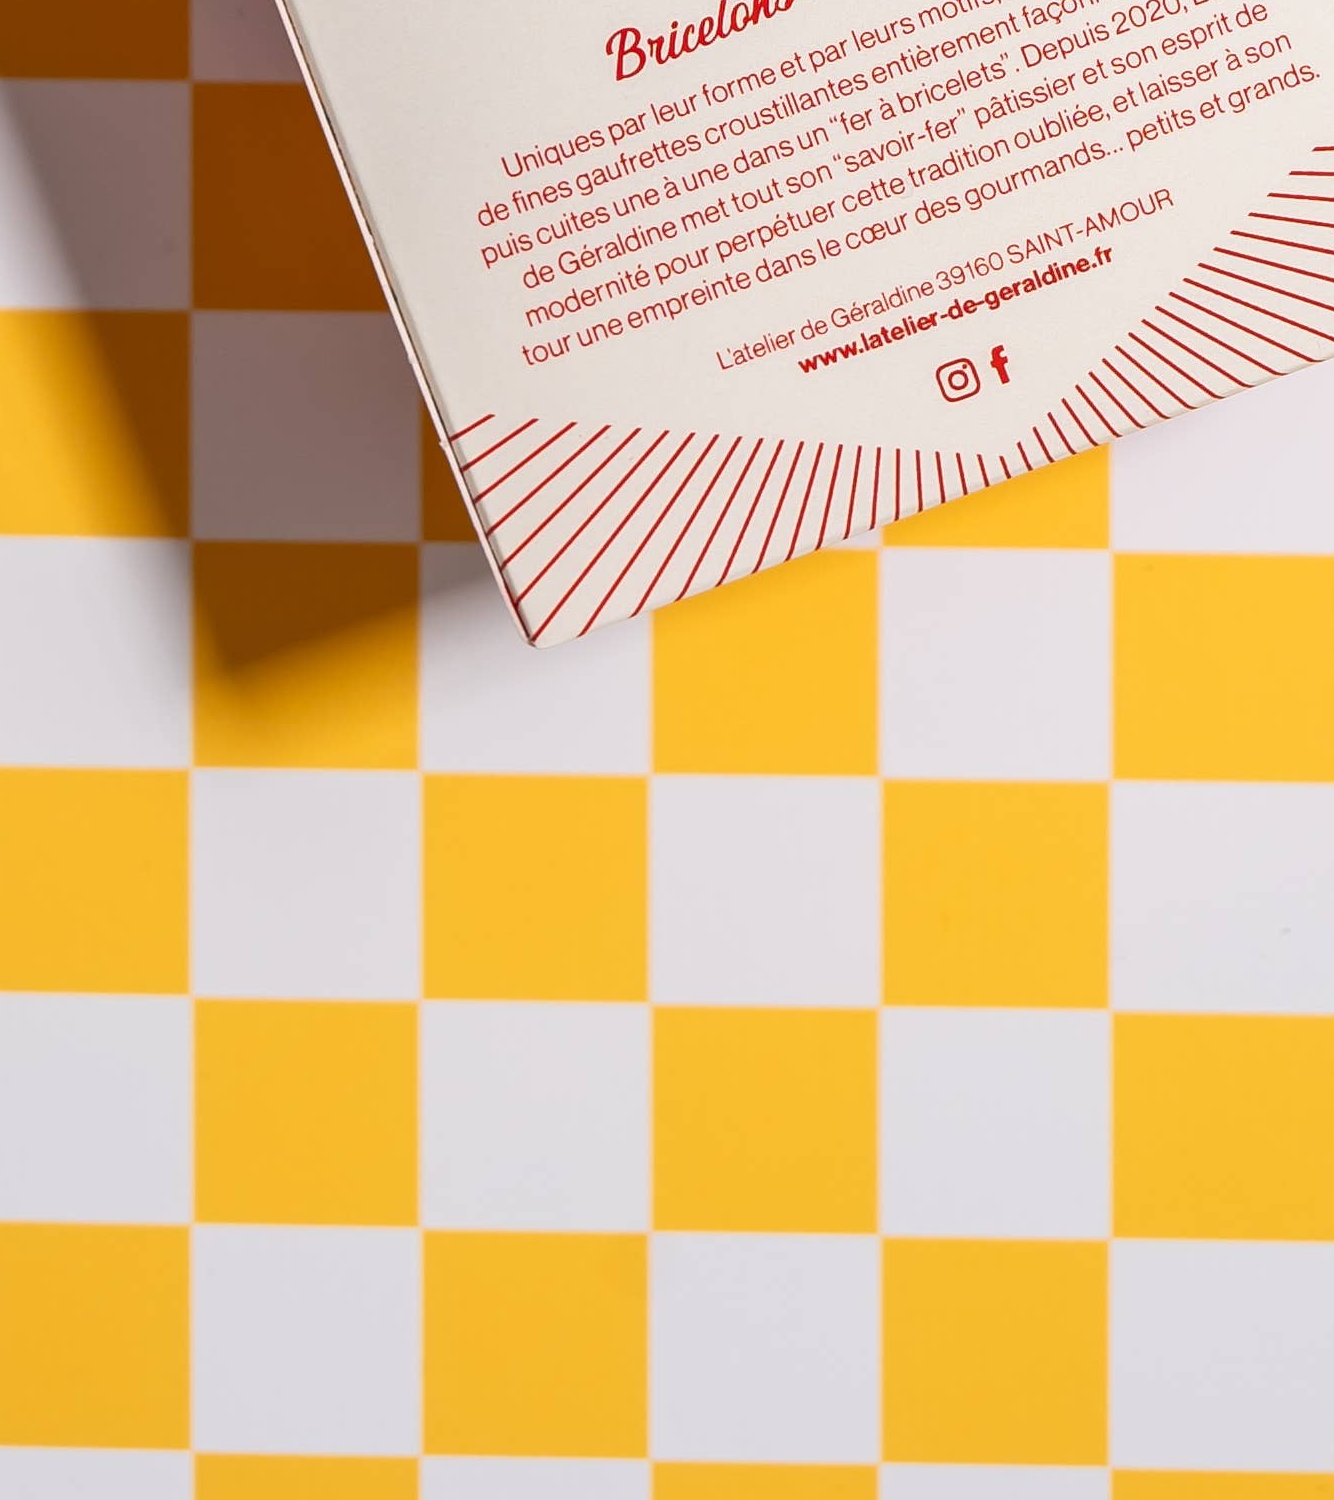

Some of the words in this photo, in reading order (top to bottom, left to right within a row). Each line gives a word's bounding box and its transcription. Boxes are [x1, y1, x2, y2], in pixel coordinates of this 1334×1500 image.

[476, 203, 511, 228] de
[510, 180, 575, 215] fines
[575, 133, 703, 197] gaufrettes
[704, 73, 870, 147] croustillantes
[870, 13, 1021, 85] entièrement
[479, 232, 534, 269] puis
[535, 206, 611, 246] cuites
[611, 188, 661, 217] une
[663, 176, 681, 200] à
[681, 162, 730, 193] une
[732, 140, 795, 175] dans
[796, 127, 830, 152] un
[878, 97, 897, 121] à
[1019, 22, 1110, 69] Depuis
[500, 129, 607, 179] Uniques
[607, 112, 647, 146] par
[650, 93, 697, 125] leur
[701, 67, 777, 107] forme
[778, 52, 807, 80] et
[808, 39, 848, 74] par
[851, 17, 916, 52] leurs
[522, 264, 556, 291] de
[557, 220, 678, 276] Géraldine
[679, 198, 731, 233] met
[730, 179, 785, 213] tout
[785, 164, 833, 195] son
[973, 73, 1076, 130] pâtissier
[1081, 58, 1109, 86] et
[1110, 44, 1158, 75] son
[1161, 13, 1232, 57] esprit
[1235, 4, 1268, 28] de
[524, 263, 651, 328] modernité
[653, 246, 709, 284] pour
[715, 200, 835, 264] perpétuer
[841, 177, 906, 213] cette
[907, 139, 1011, 188] tradition
[1012, 104, 1111, 151] oubliée,
[1112, 87, 1138, 114] et
[1138, 60, 1219, 103] laisser
[1225, 49, 1243, 71] à
[1244, 34, 1291, 64] son
[521, 334, 571, 367] tour
[576, 318, 625, 348] une
[626, 272, 752, 331] empreinte
[753, 248, 818, 283] dans
[816, 239, 843, 260] le
[844, 213, 907, 250] cœur
[914, 196, 961, 225] des
[964, 141, 1124, 212] gourmands...
[1126, 109, 1197, 152] petits
[1199, 94, 1226, 120] et
[1227, 64, 1319, 114] grands.
[717, 330, 796, 372] L’atelier
[799, 319, 829, 341] de
[829, 281, 935, 329] Géraldine
[934, 252, 1004, 292] 39160
[1005, 188, 1174, 265] SAINT-AMOUR
[796, 246, 1113, 375] www.latelier-de-geraldine.fr
